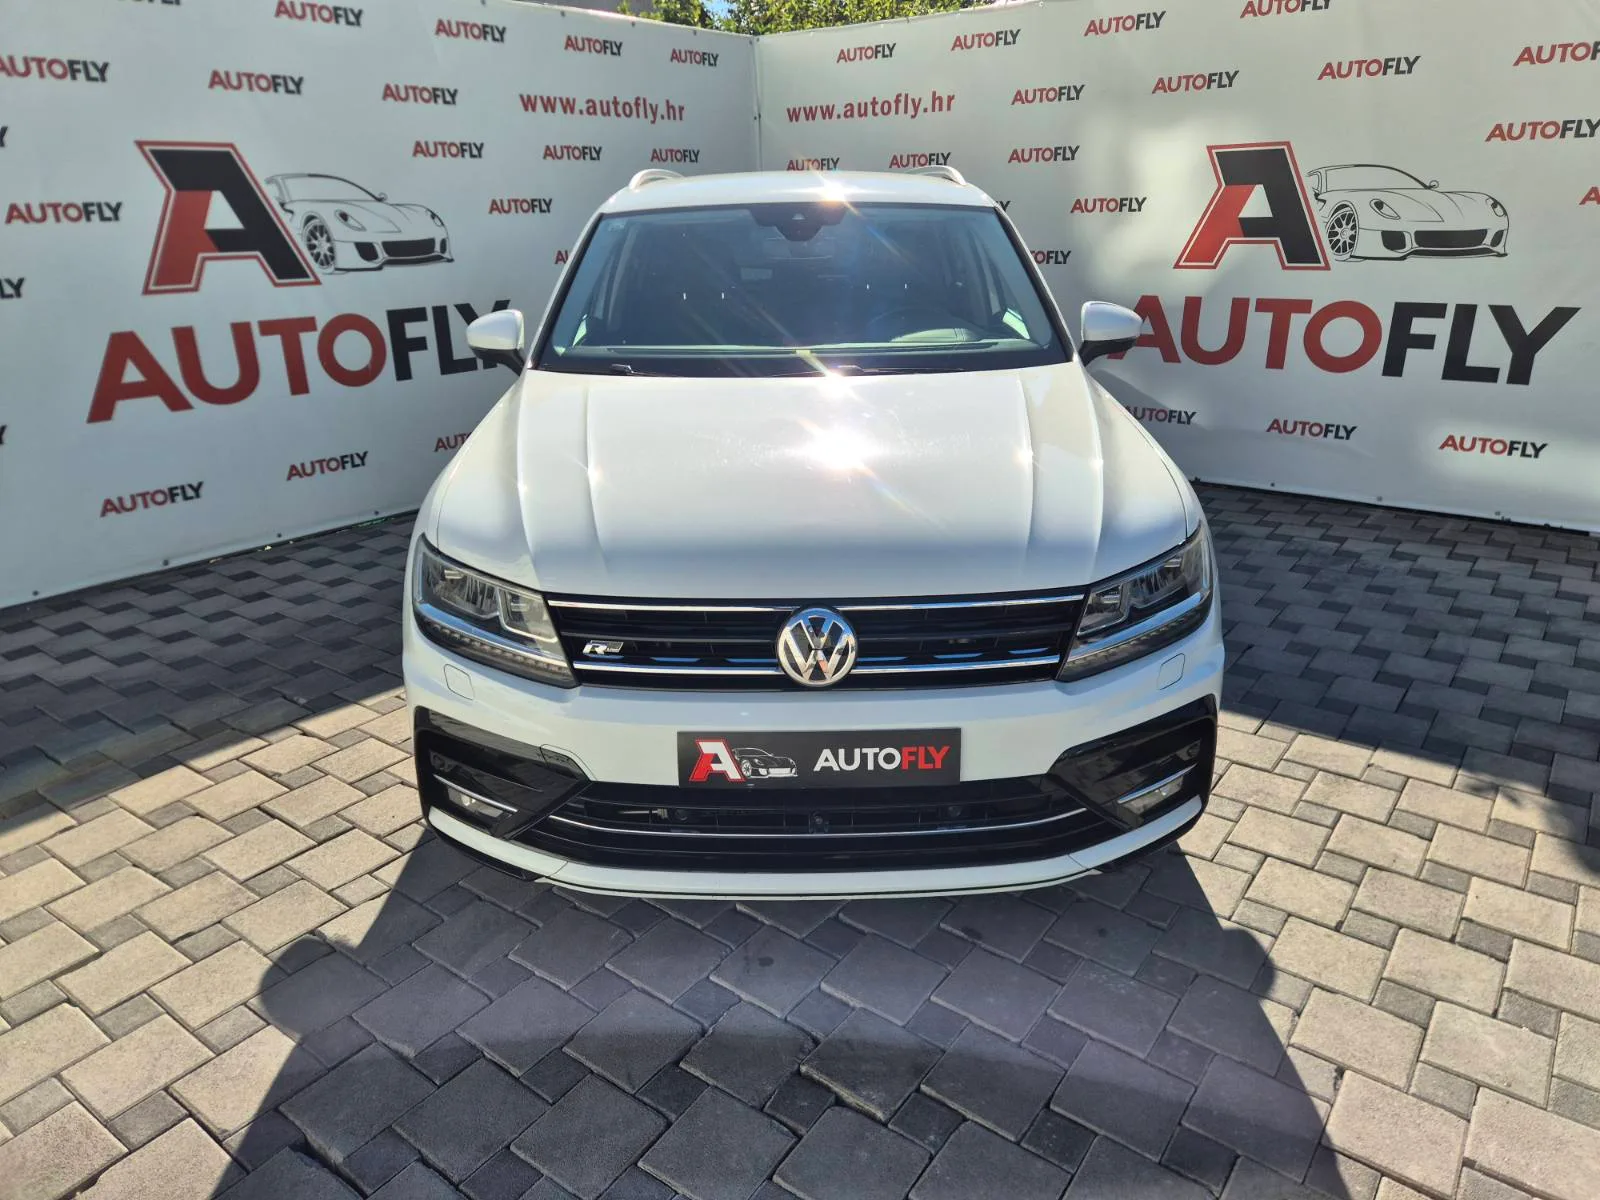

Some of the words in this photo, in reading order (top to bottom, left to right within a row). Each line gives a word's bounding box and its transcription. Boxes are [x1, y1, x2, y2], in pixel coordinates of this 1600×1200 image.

[275, 0, 363, 27] AUTOFLY
[1084, 11, 1166, 36] AUTOFLY
[435, 19, 506, 43] AUTOFLY
[951, 29, 1021, 51] AUTOFLY
[564, 35, 623, 56] AUTOFLY
[837, 43, 896, 63] AUTOFLY
[670, 48, 719, 67] AUTOFLY
[1317, 56, 1421, 80] AUTOFLY
[208, 70, 304, 95] AUTOFLY
[1152, 70, 1239, 94] AUTOFLY
[382, 83, 458, 105] AUTOFLY
[1011, 84, 1085, 105] AUTOFLY
[519, 94, 684, 124] www.autofly.hr
[786, 91, 955, 123] www.autofly.hr
[1485, 119, 1600, 142] AUTOFLY
[412, 141, 484, 159] AUTOFLY
[543, 145, 602, 161] AUTOFLY
[651, 149, 700, 163] AUTOFLY
[889, 152, 951, 168] AUTOFLY
[1008, 145, 1080, 163] AUTOFLY
[786, 157, 840, 171] AUTOFLY
[5, 202, 122, 224] AUTOFLY
[489, 198, 552, 214] AUTOFLY
[1069, 197, 1146, 214] AUTOFLY
[1106, 295, 1581, 386] AUTOFLY
[1125, 406, 1196, 425] UTOFLY
[1266, 418, 1357, 440] AUTOFLY
[1439, 435, 1548, 458] AUTOFLY
[287, 451, 368, 481] AUTOFLY
[100, 481, 204, 517] AUTOFLY
[813, 745, 950, 772] AUTOFLY
